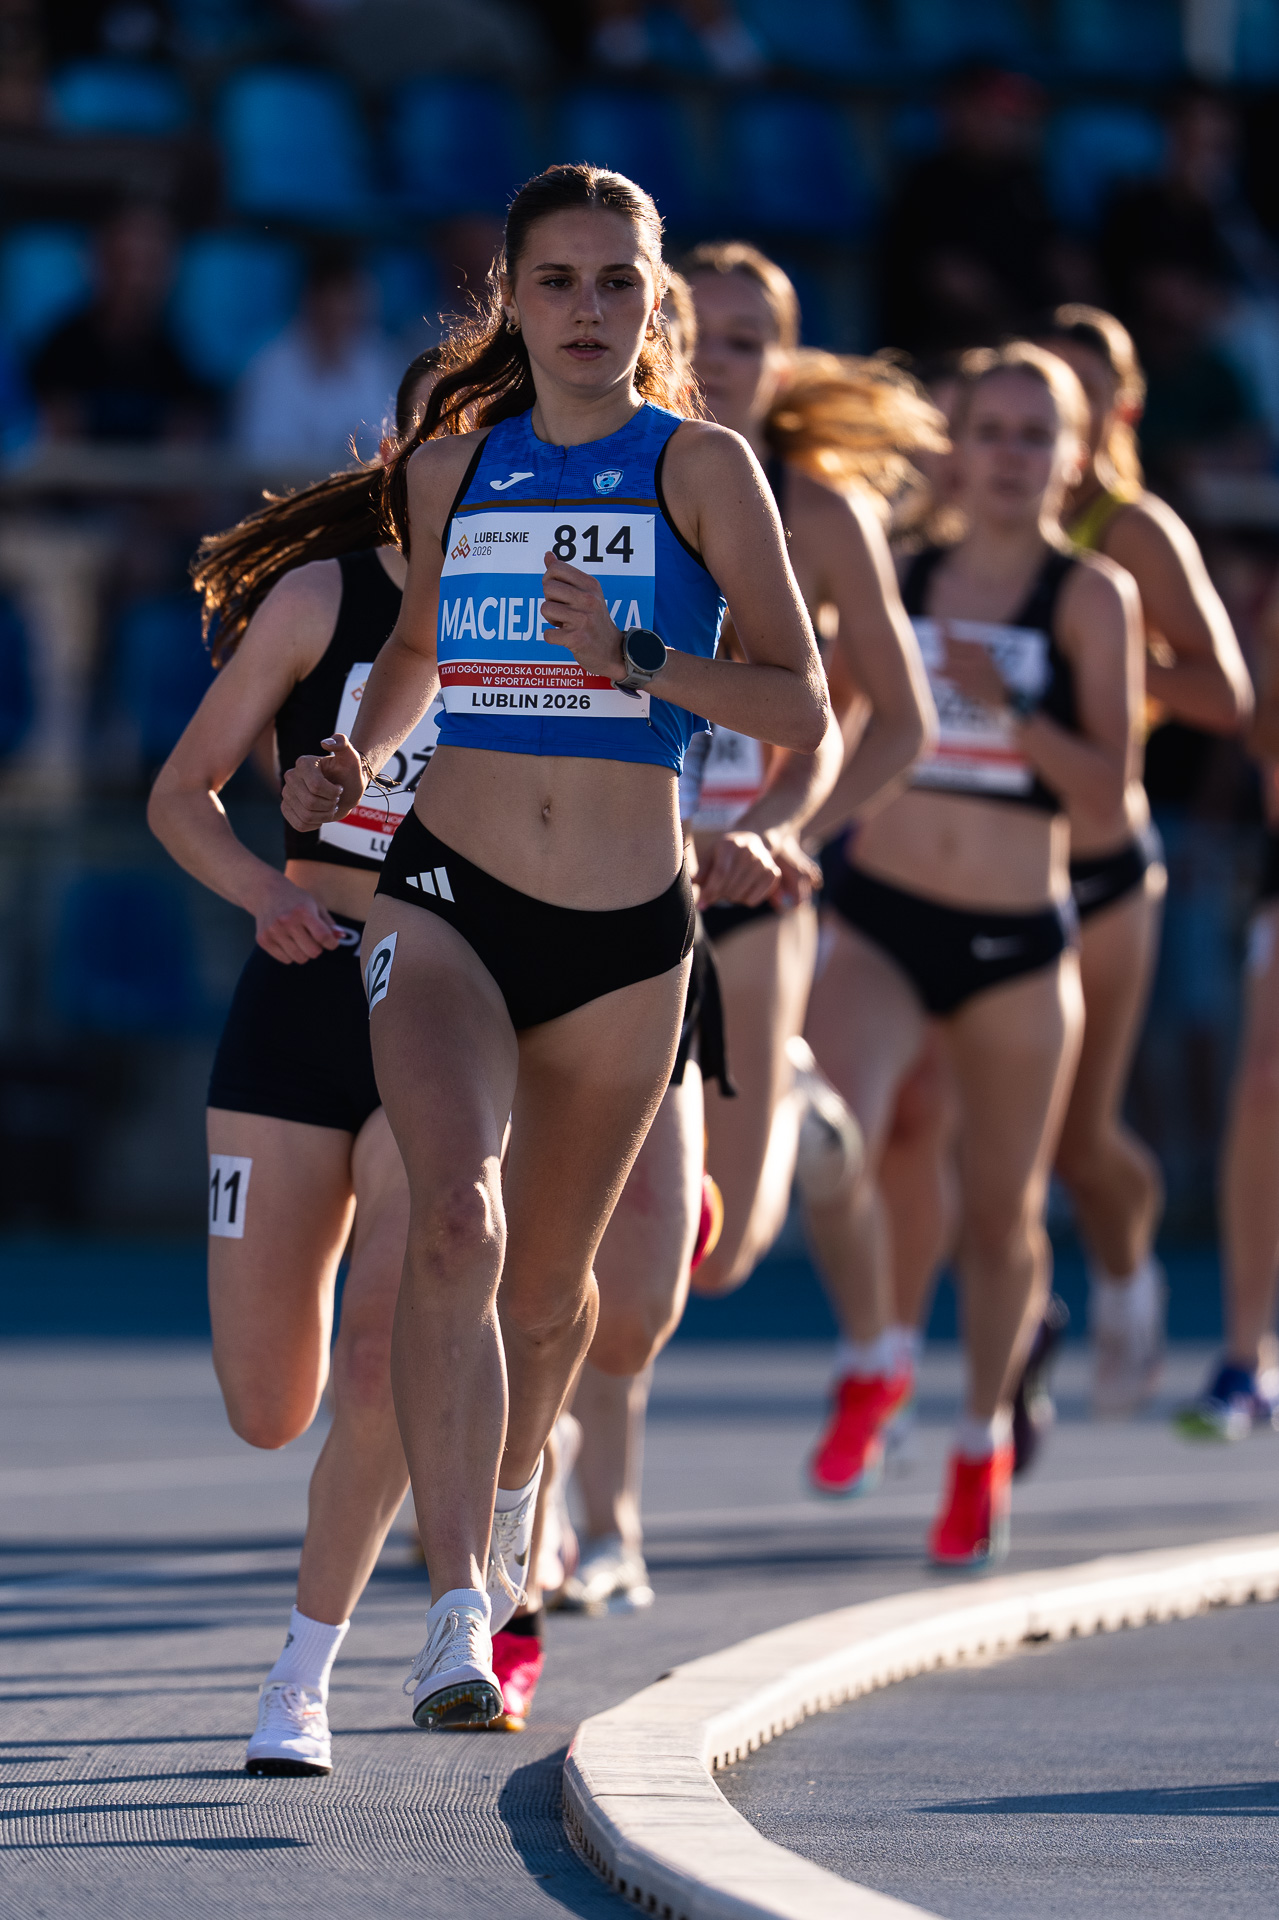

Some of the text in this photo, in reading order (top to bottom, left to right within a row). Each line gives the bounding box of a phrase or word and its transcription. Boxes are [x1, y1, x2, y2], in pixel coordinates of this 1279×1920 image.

[474, 531, 530, 543] LUBELSKIE
[552, 524, 634, 564] 814
[472, 546, 492, 556] 2026
[457, 663, 532, 676] OGÓLNOPOLSKA
[534, 667, 584, 677] OLIMPIADA
[482, 676, 584, 687] W SPORTACH LETNICH
[471, 692, 591, 710] LUBLIN 2026
[211, 1168, 241, 1223] 11
